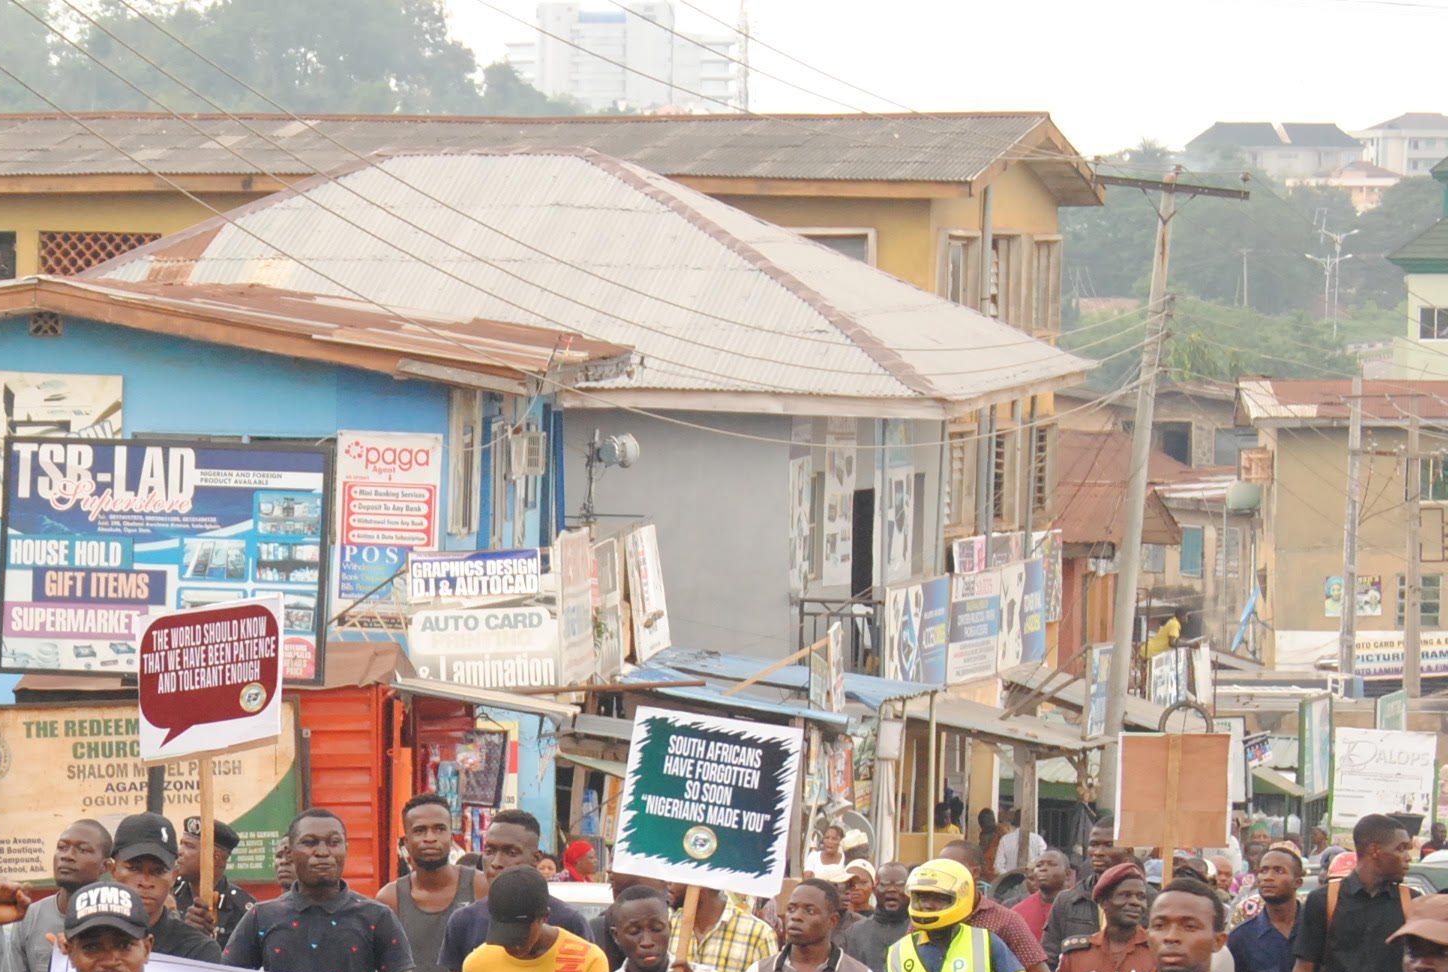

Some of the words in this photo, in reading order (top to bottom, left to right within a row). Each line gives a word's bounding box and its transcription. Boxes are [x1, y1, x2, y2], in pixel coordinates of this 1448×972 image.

[365, 446, 430, 471] paga
[200, 470, 234, 479] NIGERIAN
[235, 471, 250, 479] AND
[200, 476, 231, 485] PRODUCT
[234, 478, 269, 486] AVAILABLE
[49, 478, 193, 521] Superstore
[10, 539, 68, 566] HOUSE
[74, 540, 122, 567] HOLD
[413, 560, 484, 579] GRAPHICS
[486, 558, 537, 575] DESIGN
[45, 571, 85, 597] GIFT
[90, 572, 149, 599] ITEMS
[439, 580, 452, 596] &
[455, 575, 538, 597] AUTOCAD
[11, 606, 140, 635] SUPERMARKET
[420, 614, 479, 632] AUTO
[485, 612, 542, 630] CARD
[152, 628, 169, 651] THE
[171, 624, 201, 649] WORLD
[203, 620, 239, 645] SHOULD
[240, 616, 267, 639] KNOW
[142, 651, 166, 674] THAT
[166, 650, 181, 671] WE
[183, 646, 206, 669] HAVE
[208, 642, 232, 667] BEEN
[233, 636, 276, 662] PATIENCE
[157, 672, 176, 694] AND
[178, 665, 224, 692] TOLERANT
[225, 660, 260, 685] ENOUGH
[439, 654, 555, 688] Lamination
[23, 720, 59, 738] THE
[64, 718, 140, 738] REDEEM
[72, 740, 140, 760] CHURC
[668, 735, 706, 759] SOUTH
[707, 742, 763, 768] AFRICANS
[67, 763, 129, 781] SHALOM
[189, 759, 242, 777] PRISH
[663, 756, 694, 778] HAVE
[695, 760, 760, 790] FORGOTTEN
[105, 781, 150, 793] AGAP
[164, 780, 201, 792] ZON
[684, 780, 699, 799] SO
[701, 783, 733, 806] SOON
[82, 795, 129, 807] OGUN
[222, 794, 231, 804] 6
[641, 793, 707, 823] “NIGERIANS
[706, 805, 740, 829] MADE
[742, 809, 772, 833] YOU”
[7, 847, 45, 856] Boutique,
